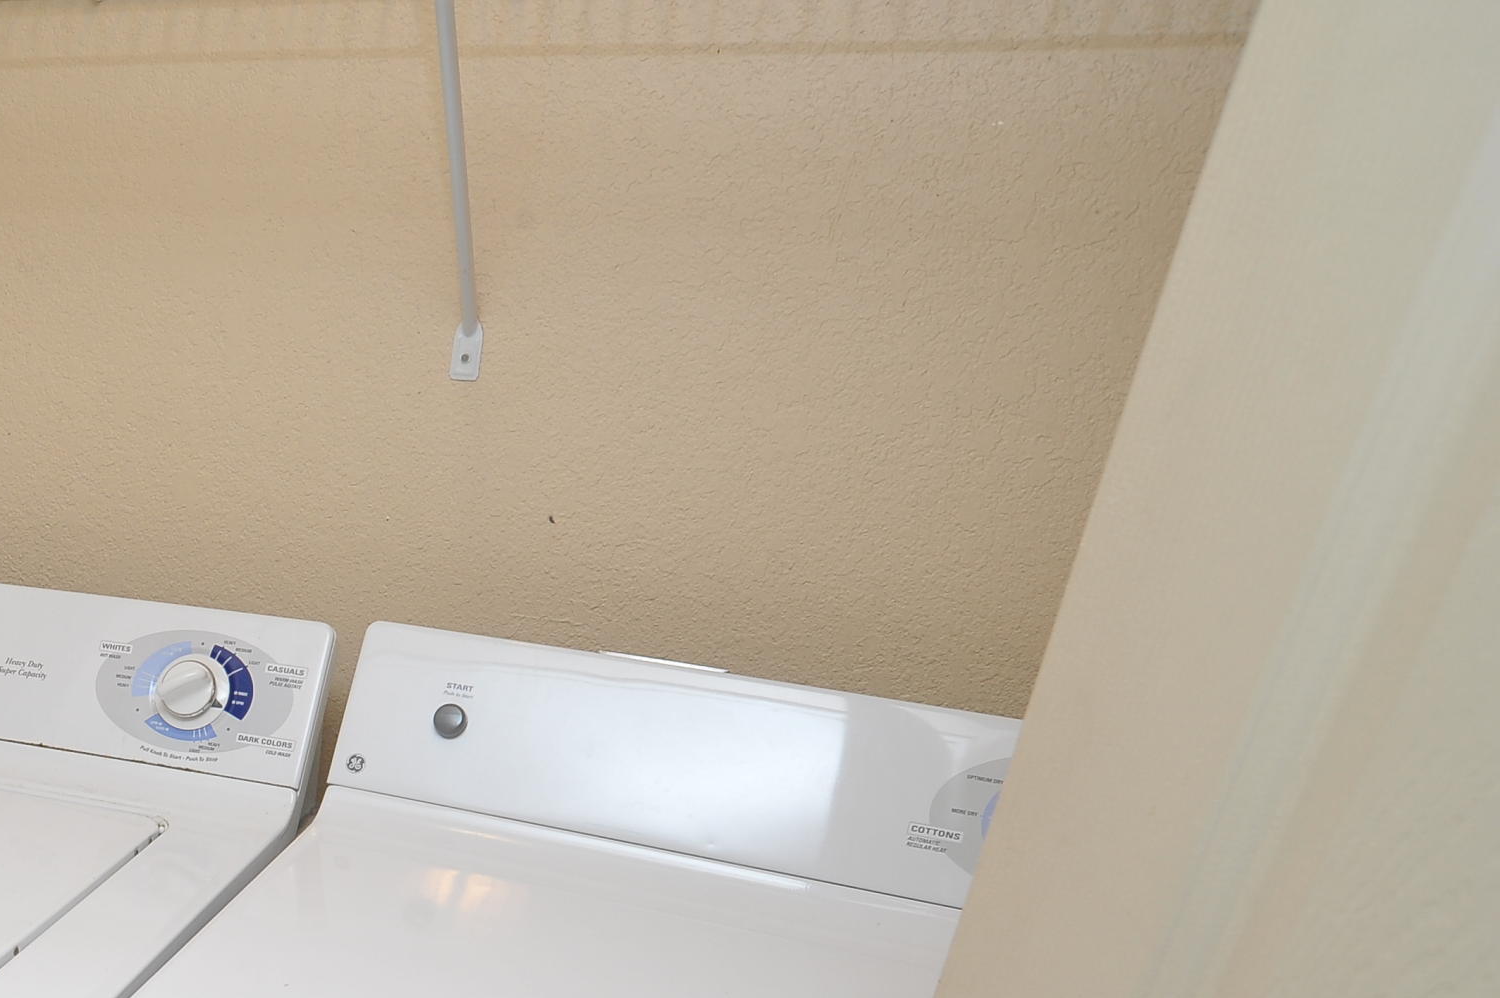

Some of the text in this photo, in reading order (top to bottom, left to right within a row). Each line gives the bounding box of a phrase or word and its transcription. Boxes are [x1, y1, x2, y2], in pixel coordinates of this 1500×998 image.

[102, 643, 131, 652] WHITES
[5, 657, 44, 670] Heavy Duty
[18, 669, 46, 681] Capacity
[268, 665, 305, 676] CASUALS
[446, 682, 473, 692] START
[238, 734, 293, 750] DARK COLORS
[966, 774, 992, 784] OPTIMUM
[911, 825, 961, 841] COTTONS
